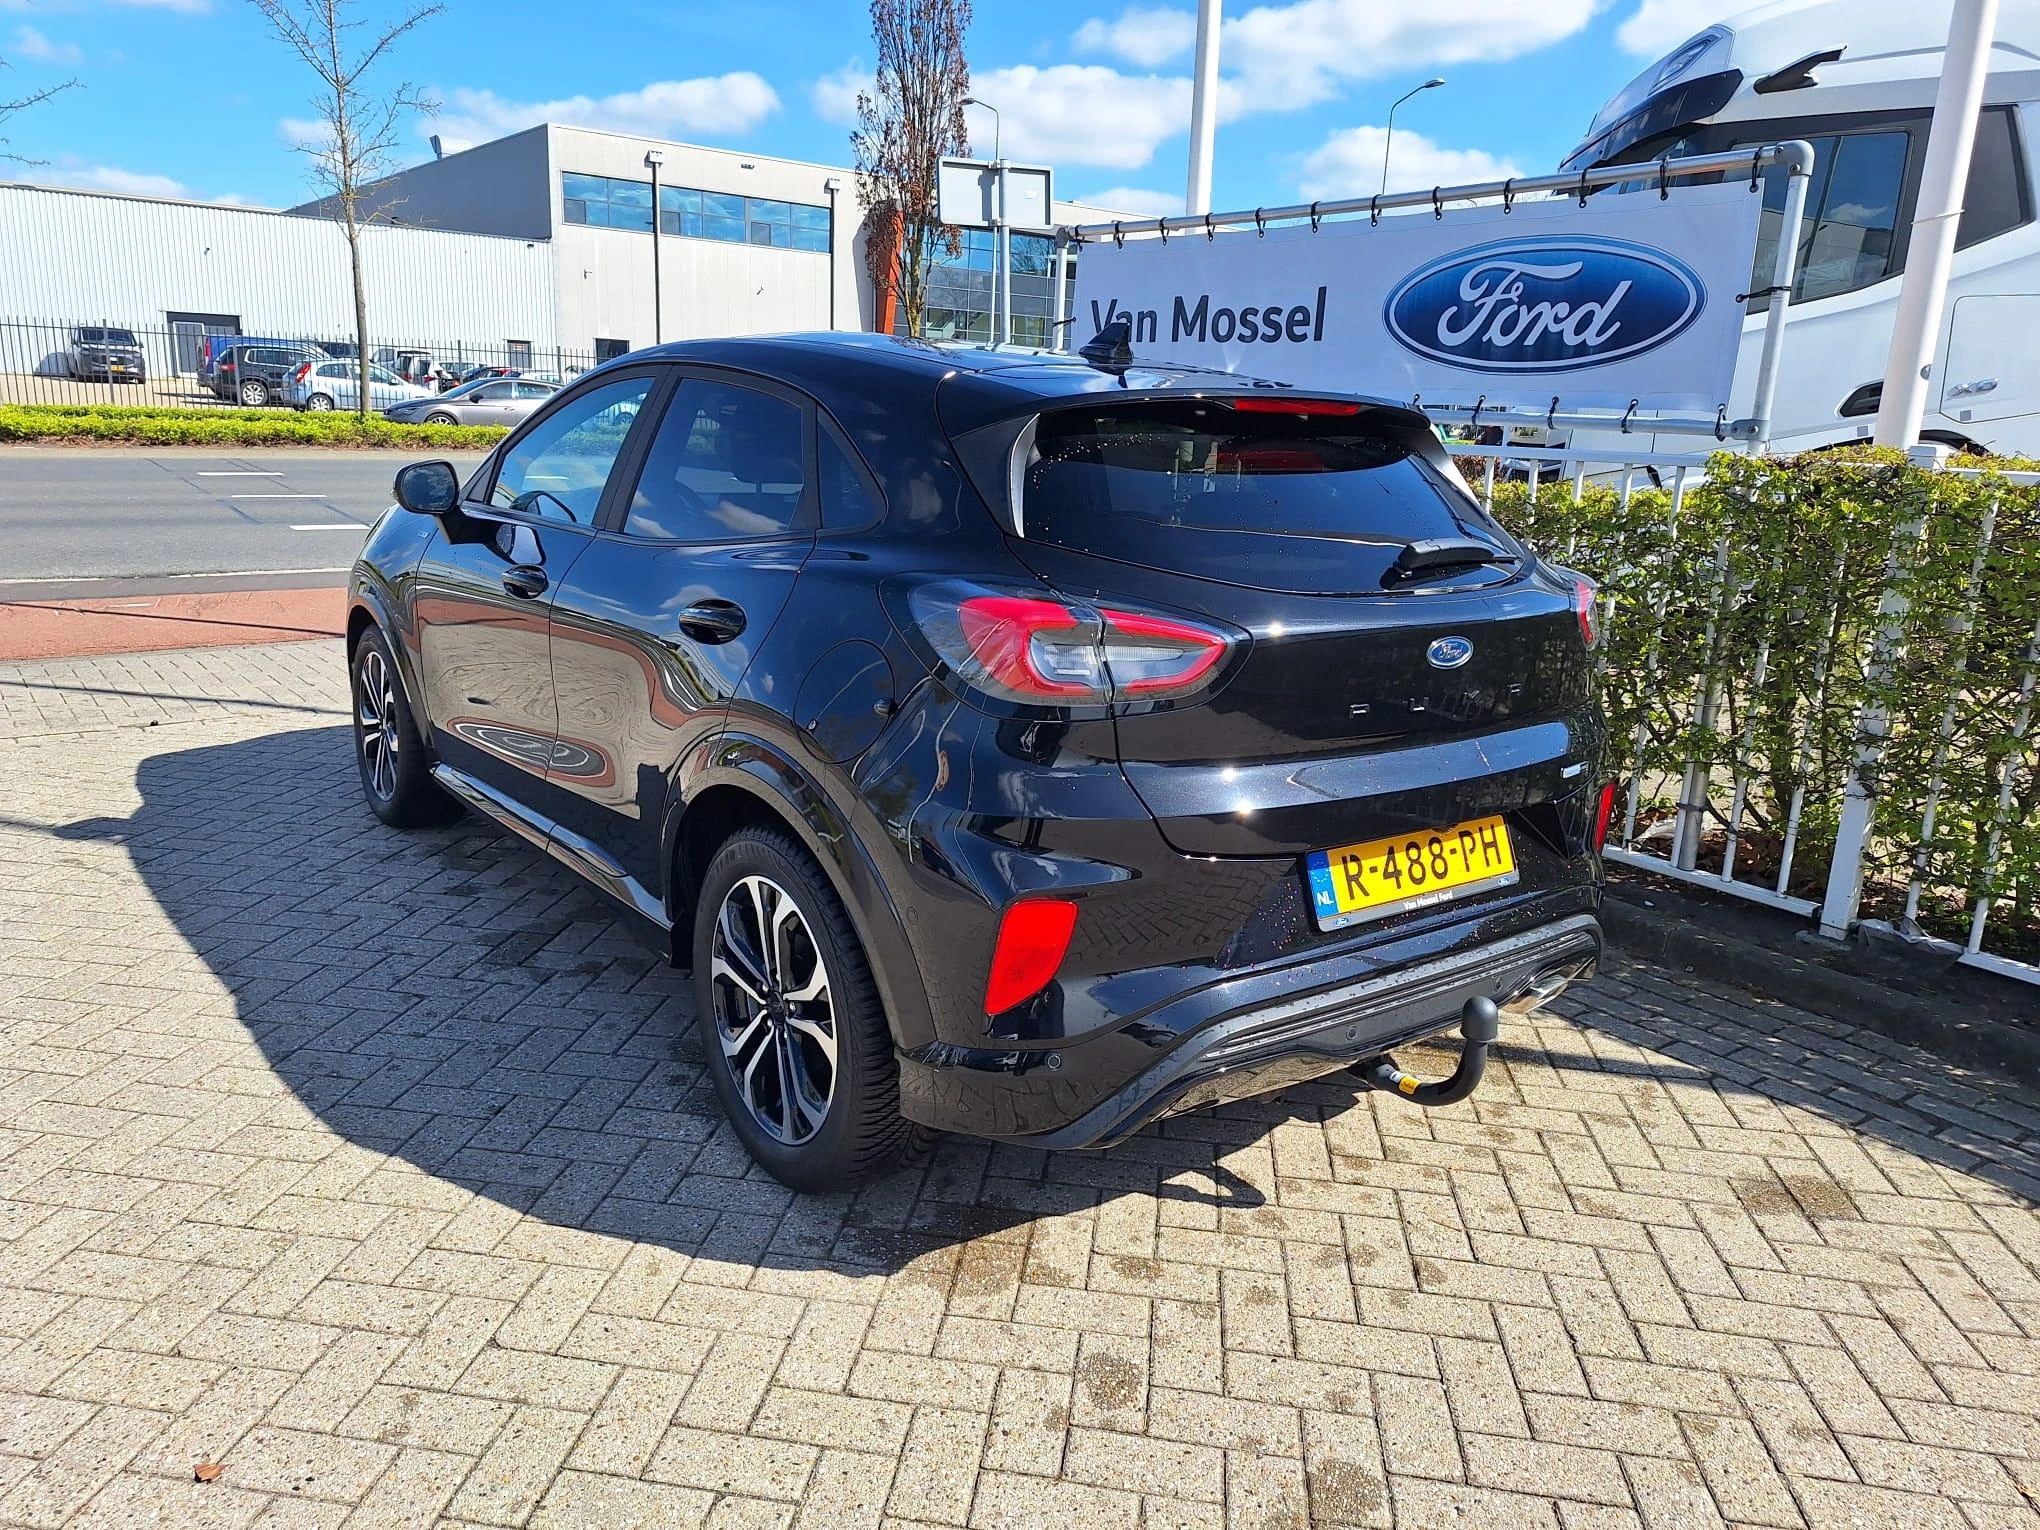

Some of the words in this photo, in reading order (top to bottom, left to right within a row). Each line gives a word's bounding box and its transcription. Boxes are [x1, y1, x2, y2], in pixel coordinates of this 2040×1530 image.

[1091, 298, 1157, 342] Van
[1171, 286, 1327, 343] Mossel
[1437, 261, 1632, 347] Ford
[1341, 824, 1502, 900] R-488-PH
[1317, 891, 1334, 907] NL
[1438, 890, 1453, 902] Ford
